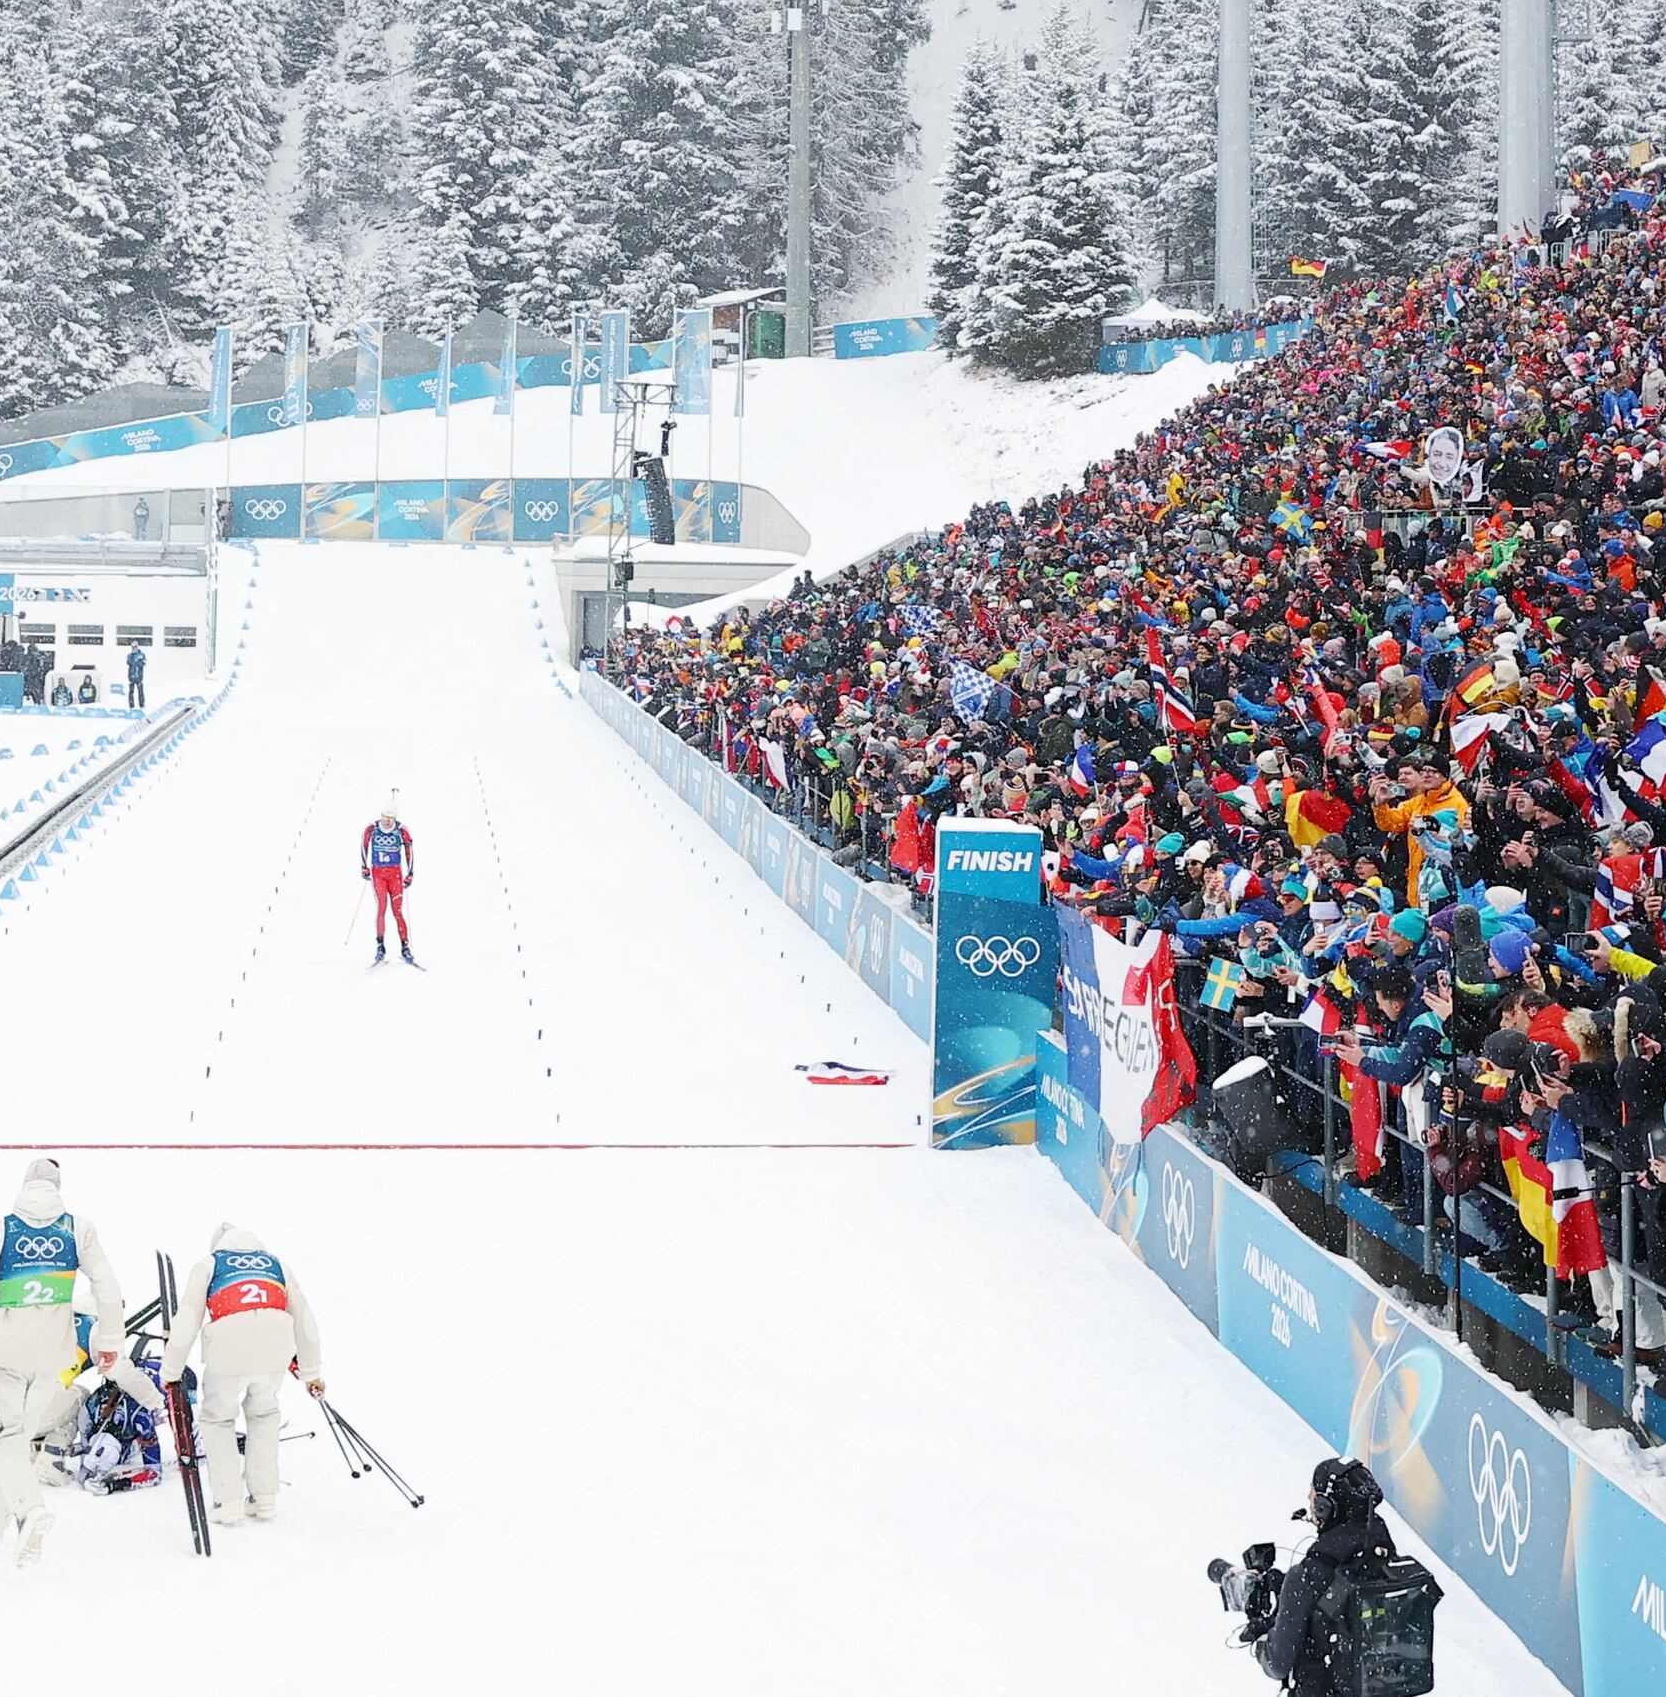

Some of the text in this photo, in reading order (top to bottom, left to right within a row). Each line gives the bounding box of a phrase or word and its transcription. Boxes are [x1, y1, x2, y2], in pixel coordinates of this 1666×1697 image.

[0, 586, 36, 601] 2026
[947, 850, 1033, 872] FINISH
[1243, 1242, 1320, 1334] MILANO CORTINA
[1271, 1303, 1291, 1349] 2026
